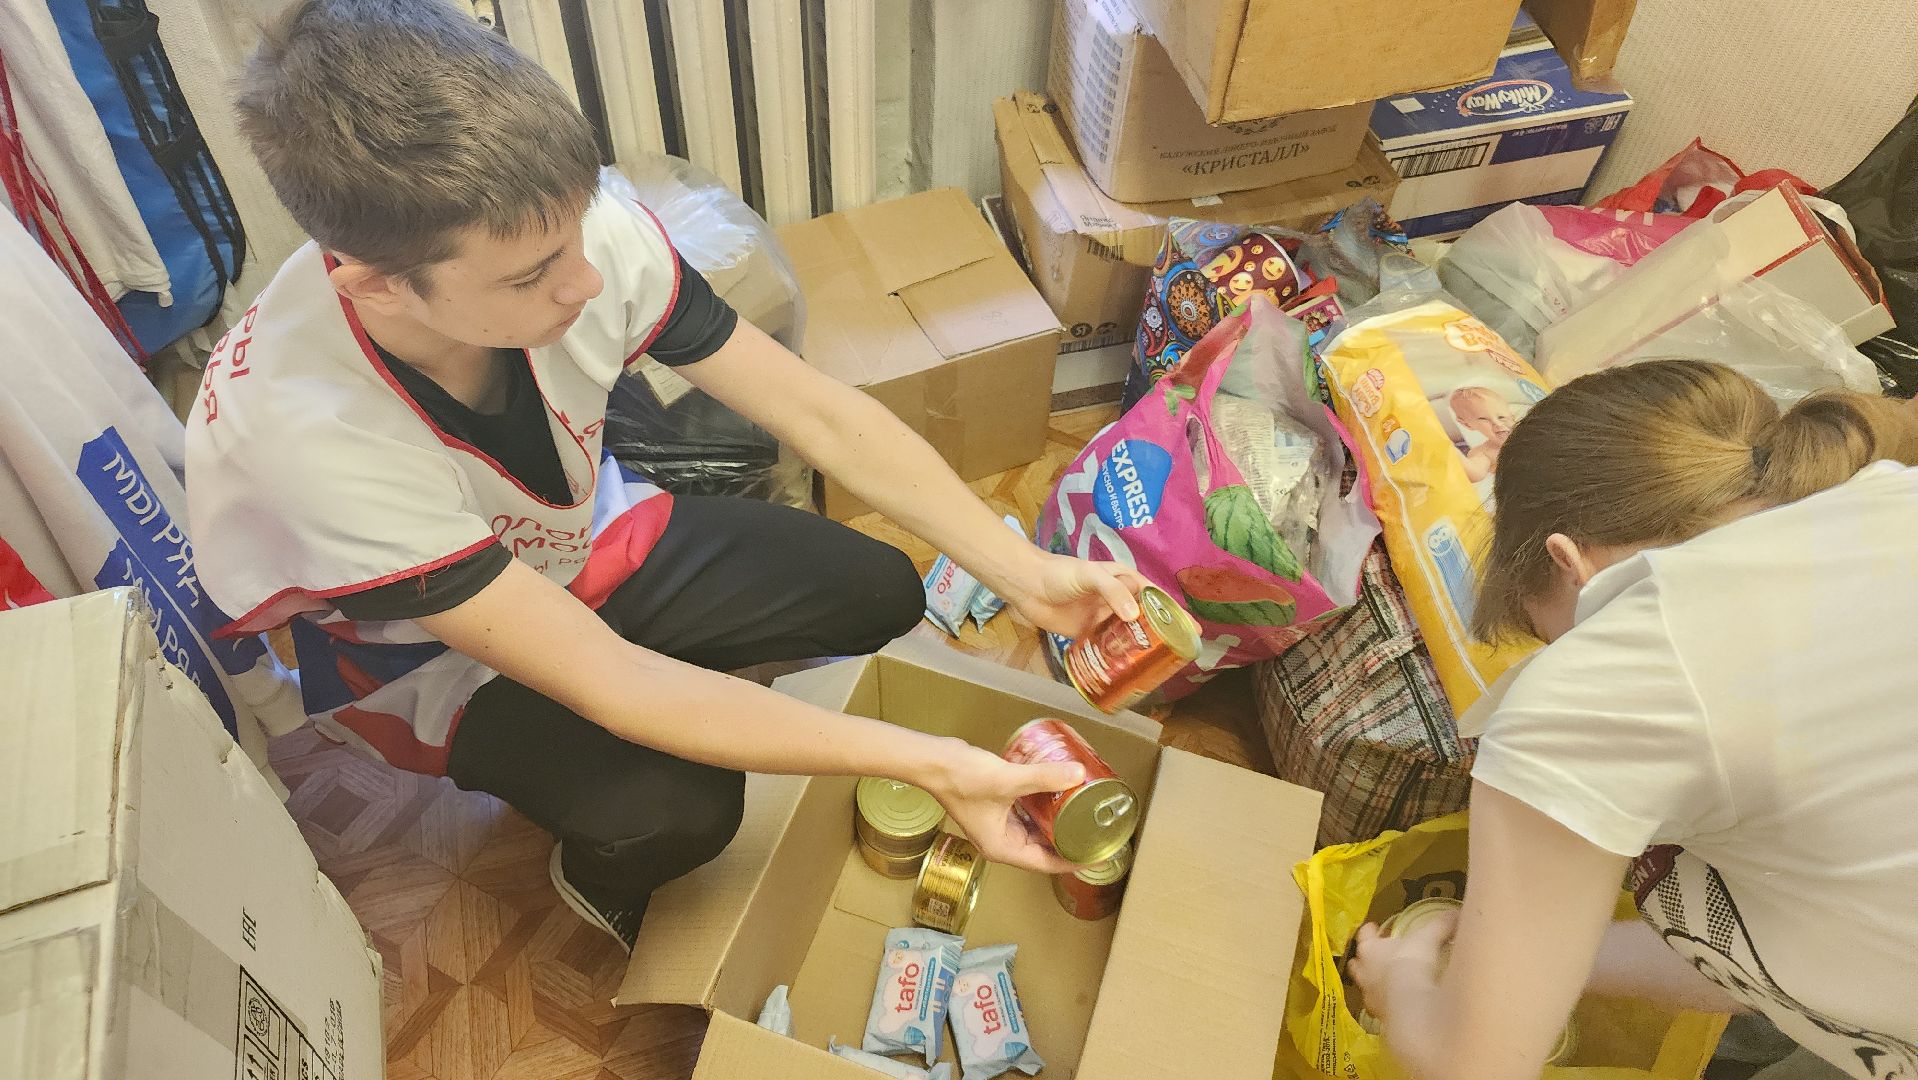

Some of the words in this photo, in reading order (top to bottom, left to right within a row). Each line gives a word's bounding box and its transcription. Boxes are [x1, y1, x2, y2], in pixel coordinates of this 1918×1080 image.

[1111, 438, 1154, 530] EXPRESS
[895, 963, 920, 1013] tafo
[974, 984, 1001, 1035] tafo
